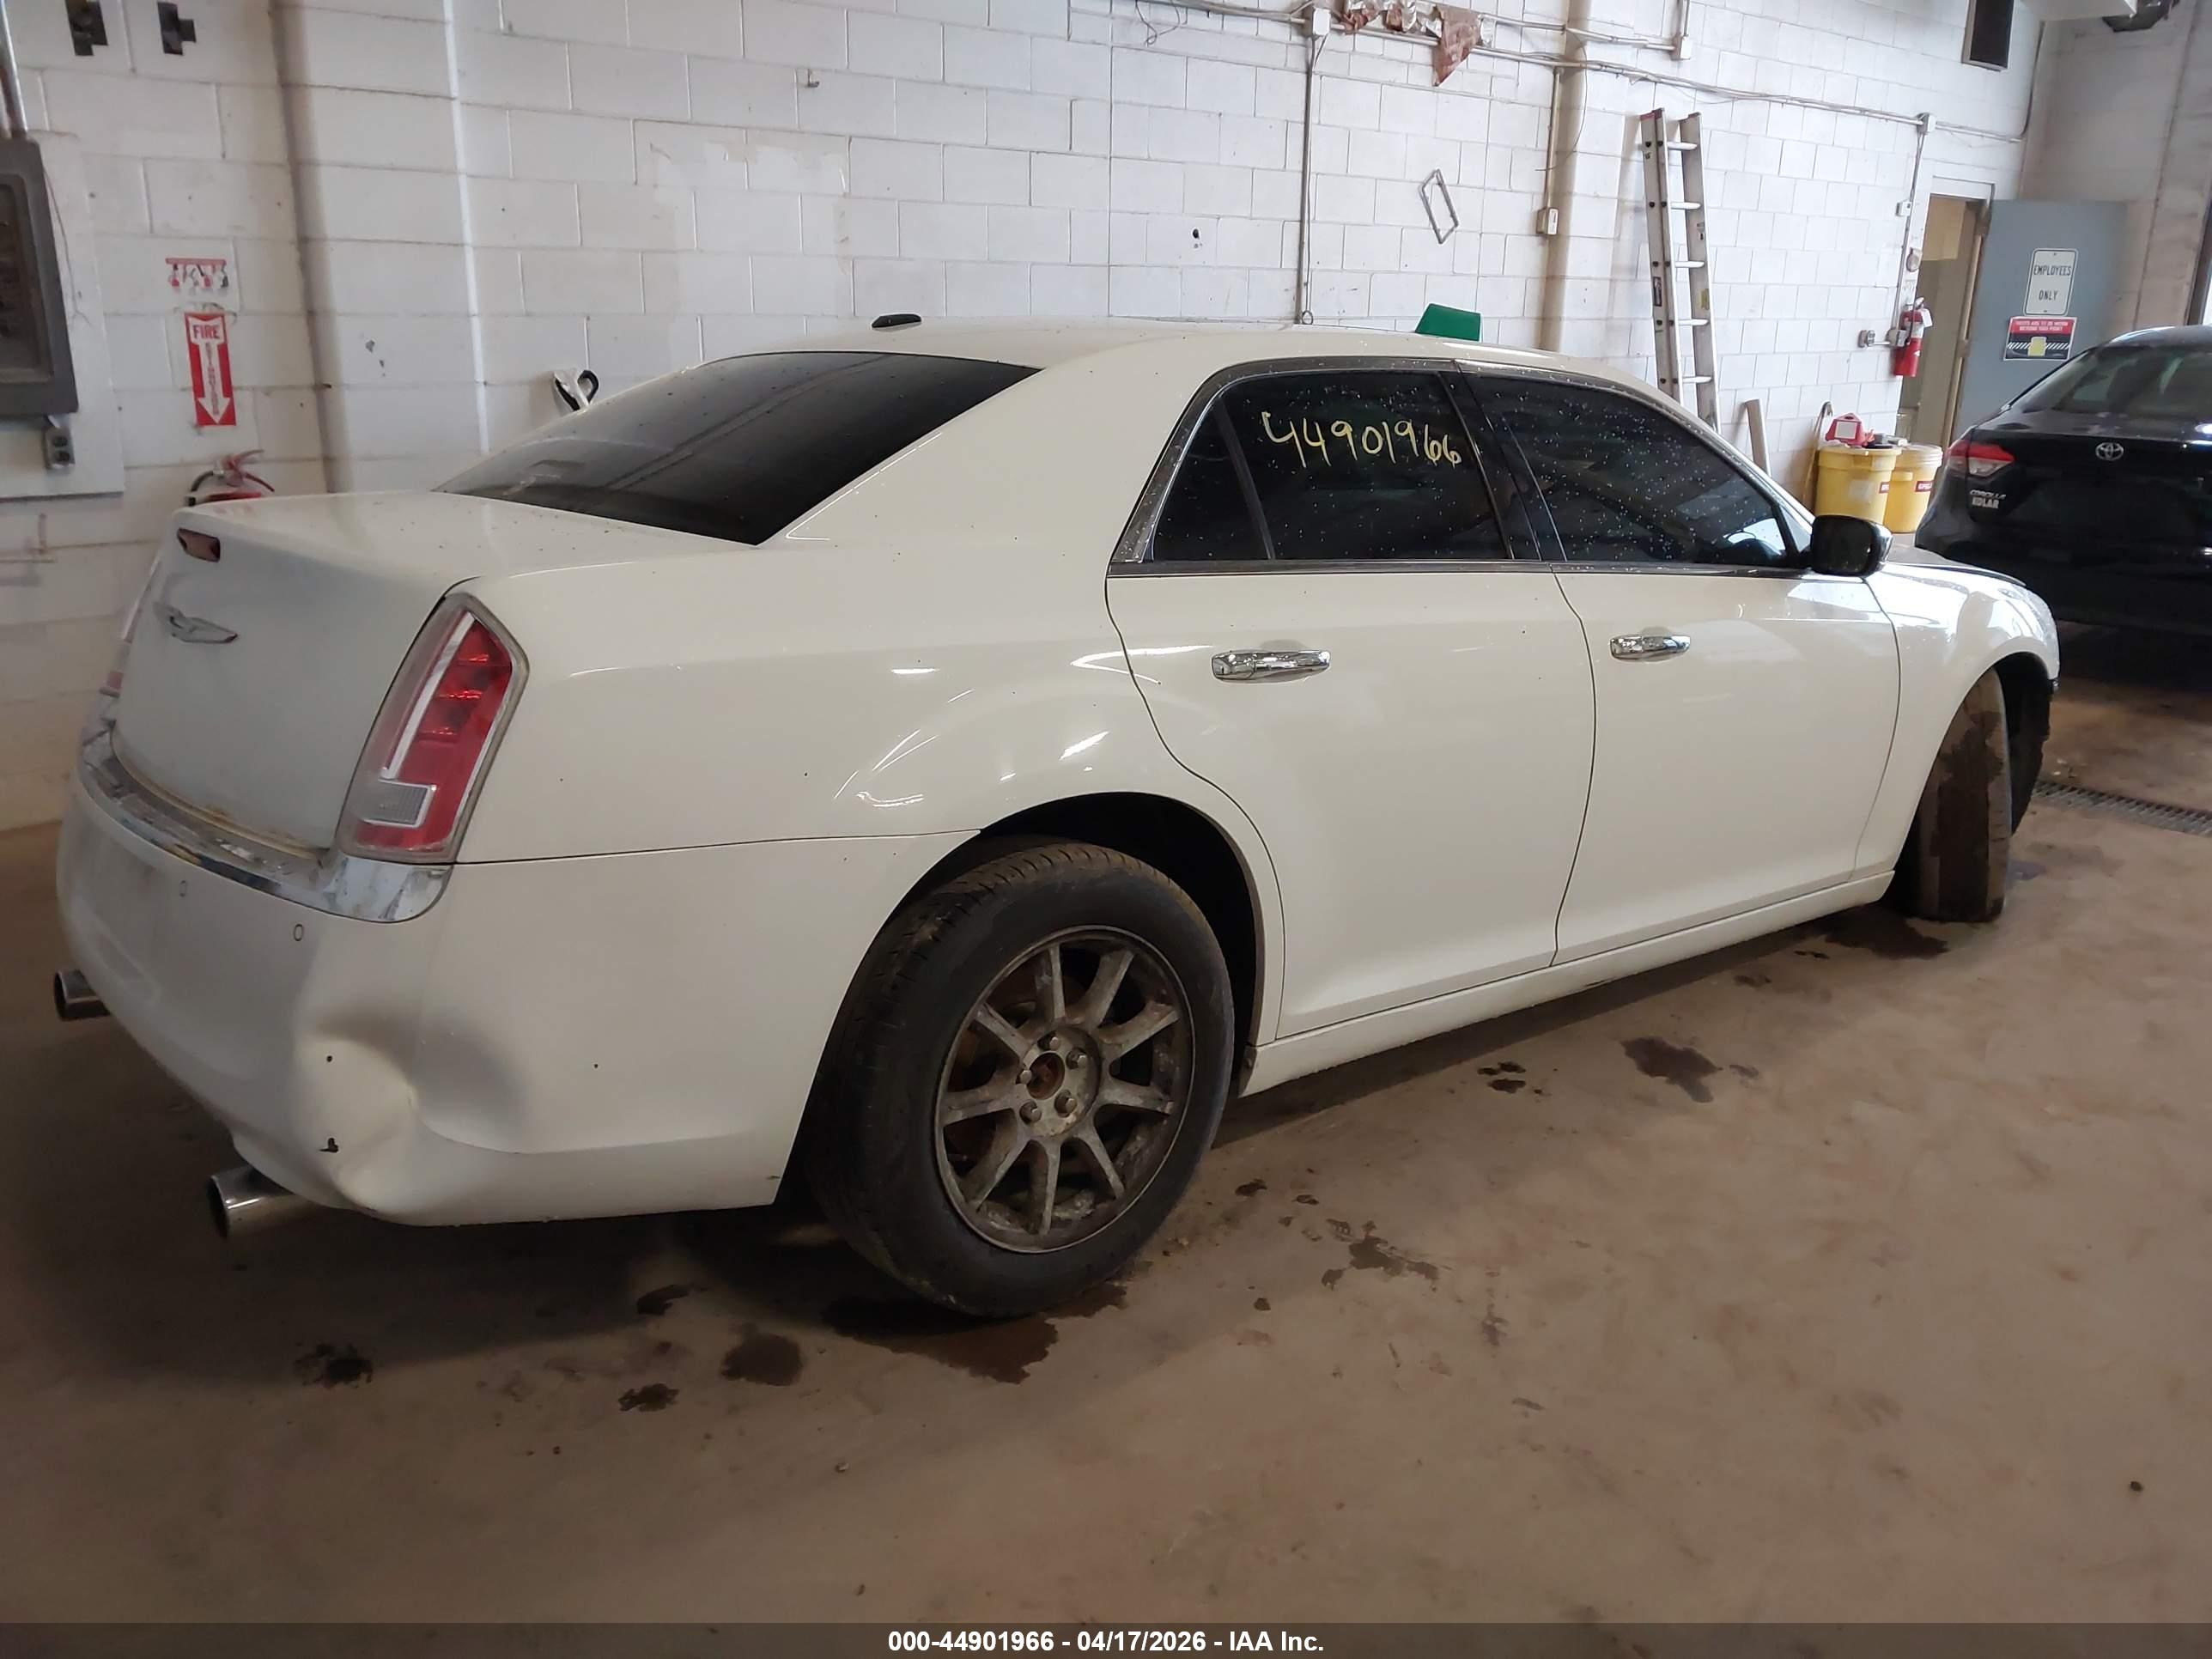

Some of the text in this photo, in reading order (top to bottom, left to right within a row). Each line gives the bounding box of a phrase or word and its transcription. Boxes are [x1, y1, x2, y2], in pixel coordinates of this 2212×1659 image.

[2033, 264, 2072, 276] EMPLOYEES
[2039, 290, 2058, 301] ONLY
[192, 325, 220, 339] FIRE
[1261, 411, 1462, 468] 44901966
